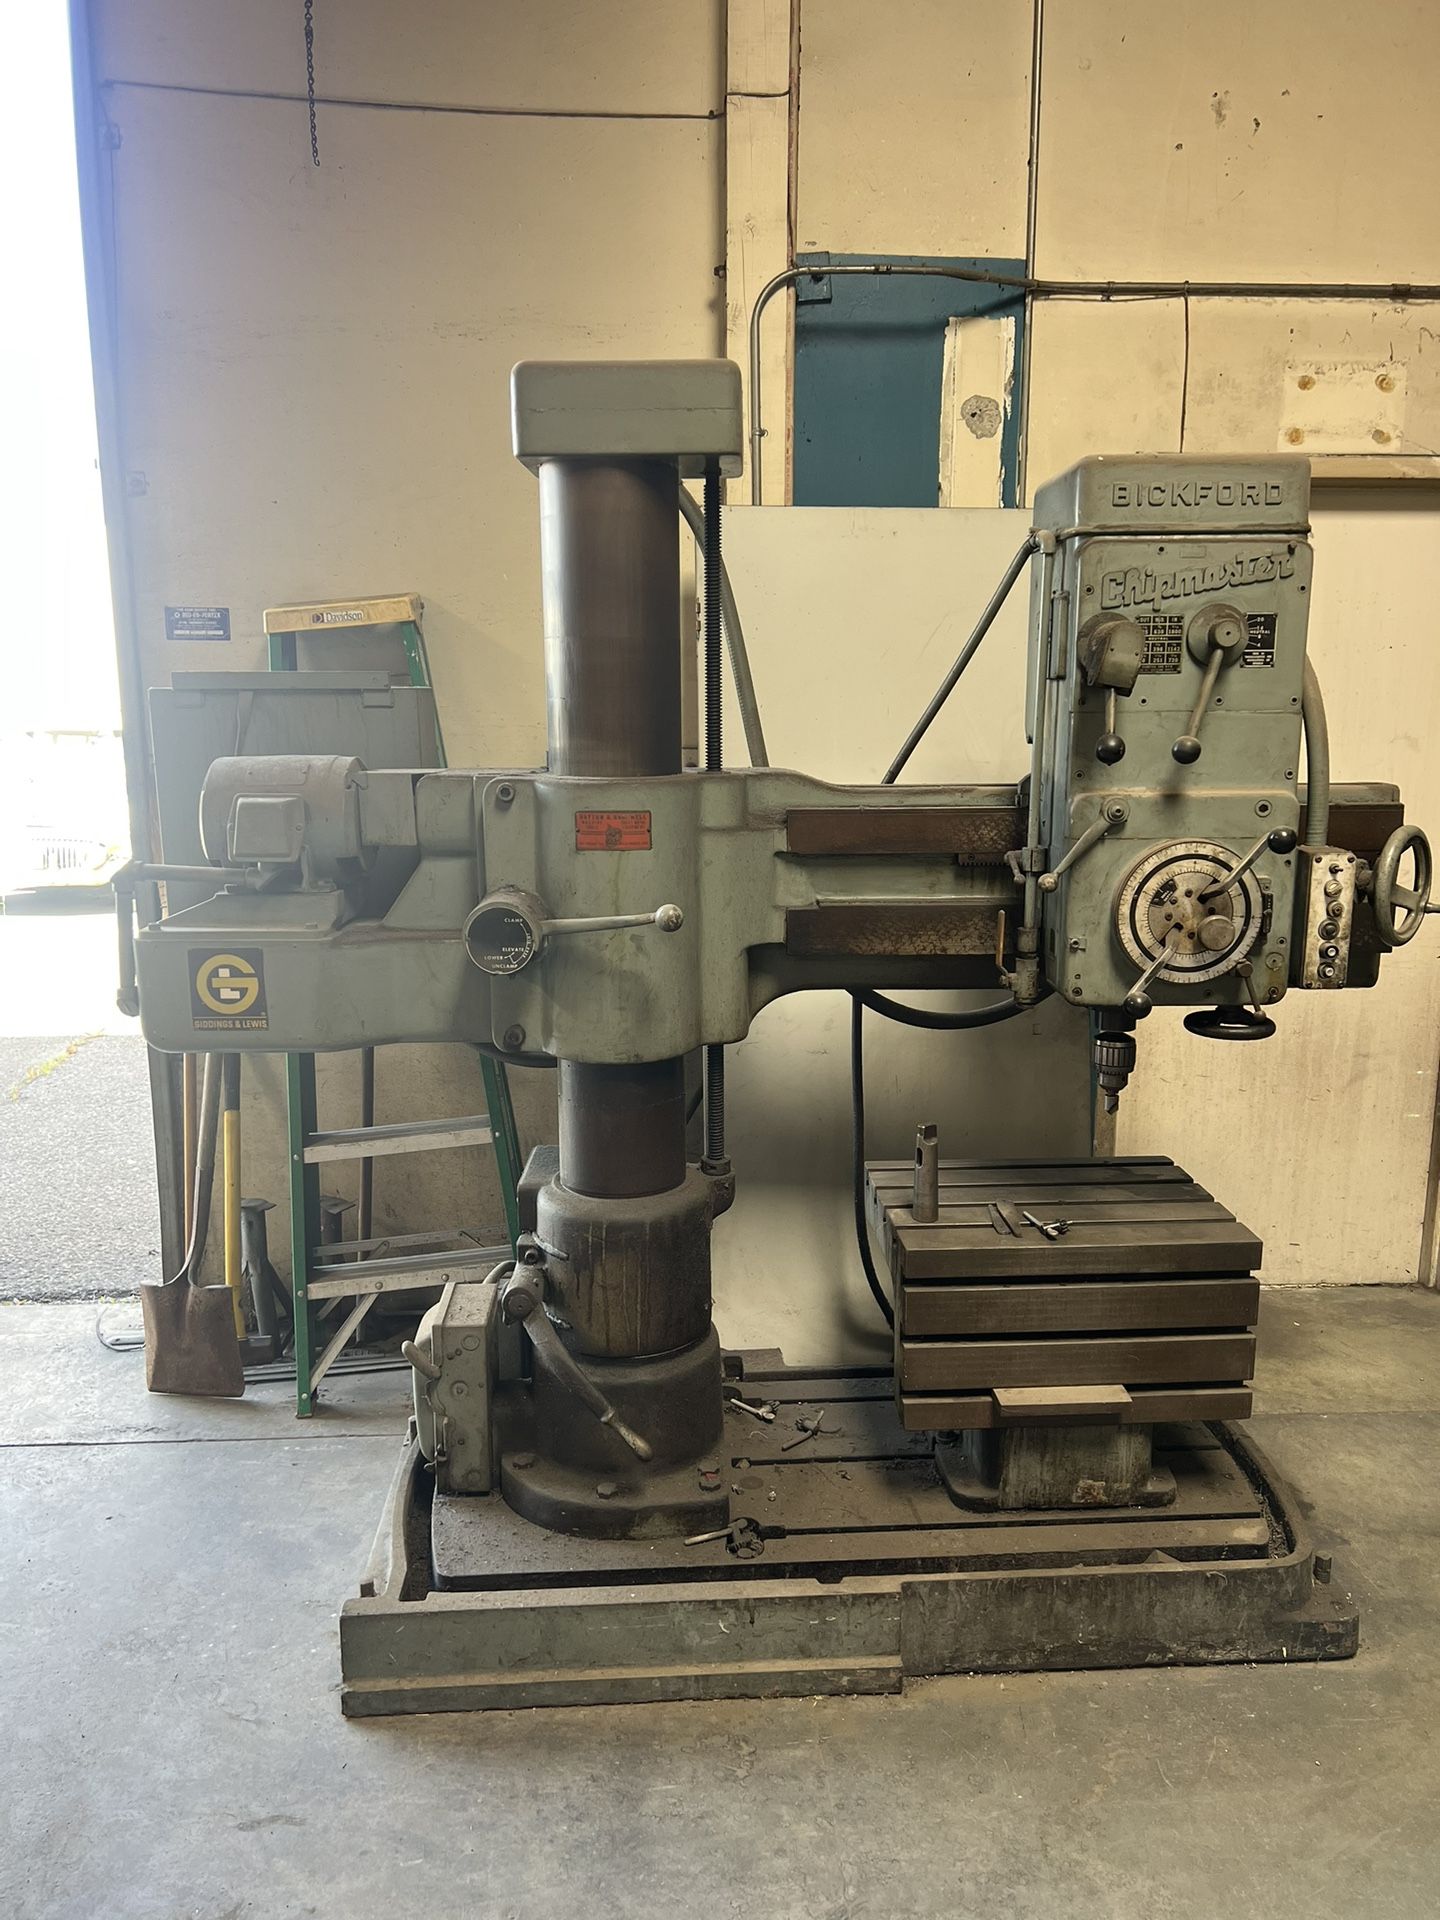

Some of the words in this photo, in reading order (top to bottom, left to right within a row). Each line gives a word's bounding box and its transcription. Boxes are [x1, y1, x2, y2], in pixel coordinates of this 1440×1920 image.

[1112, 481, 1283, 507] BICKFORD
[1101, 552, 1295, 611] Chipmaster
[325, 609, 364, 623] Davidson
[193, 1020, 234, 1028] GIDDINGS
[242, 1020, 268, 1028] LEWIS
